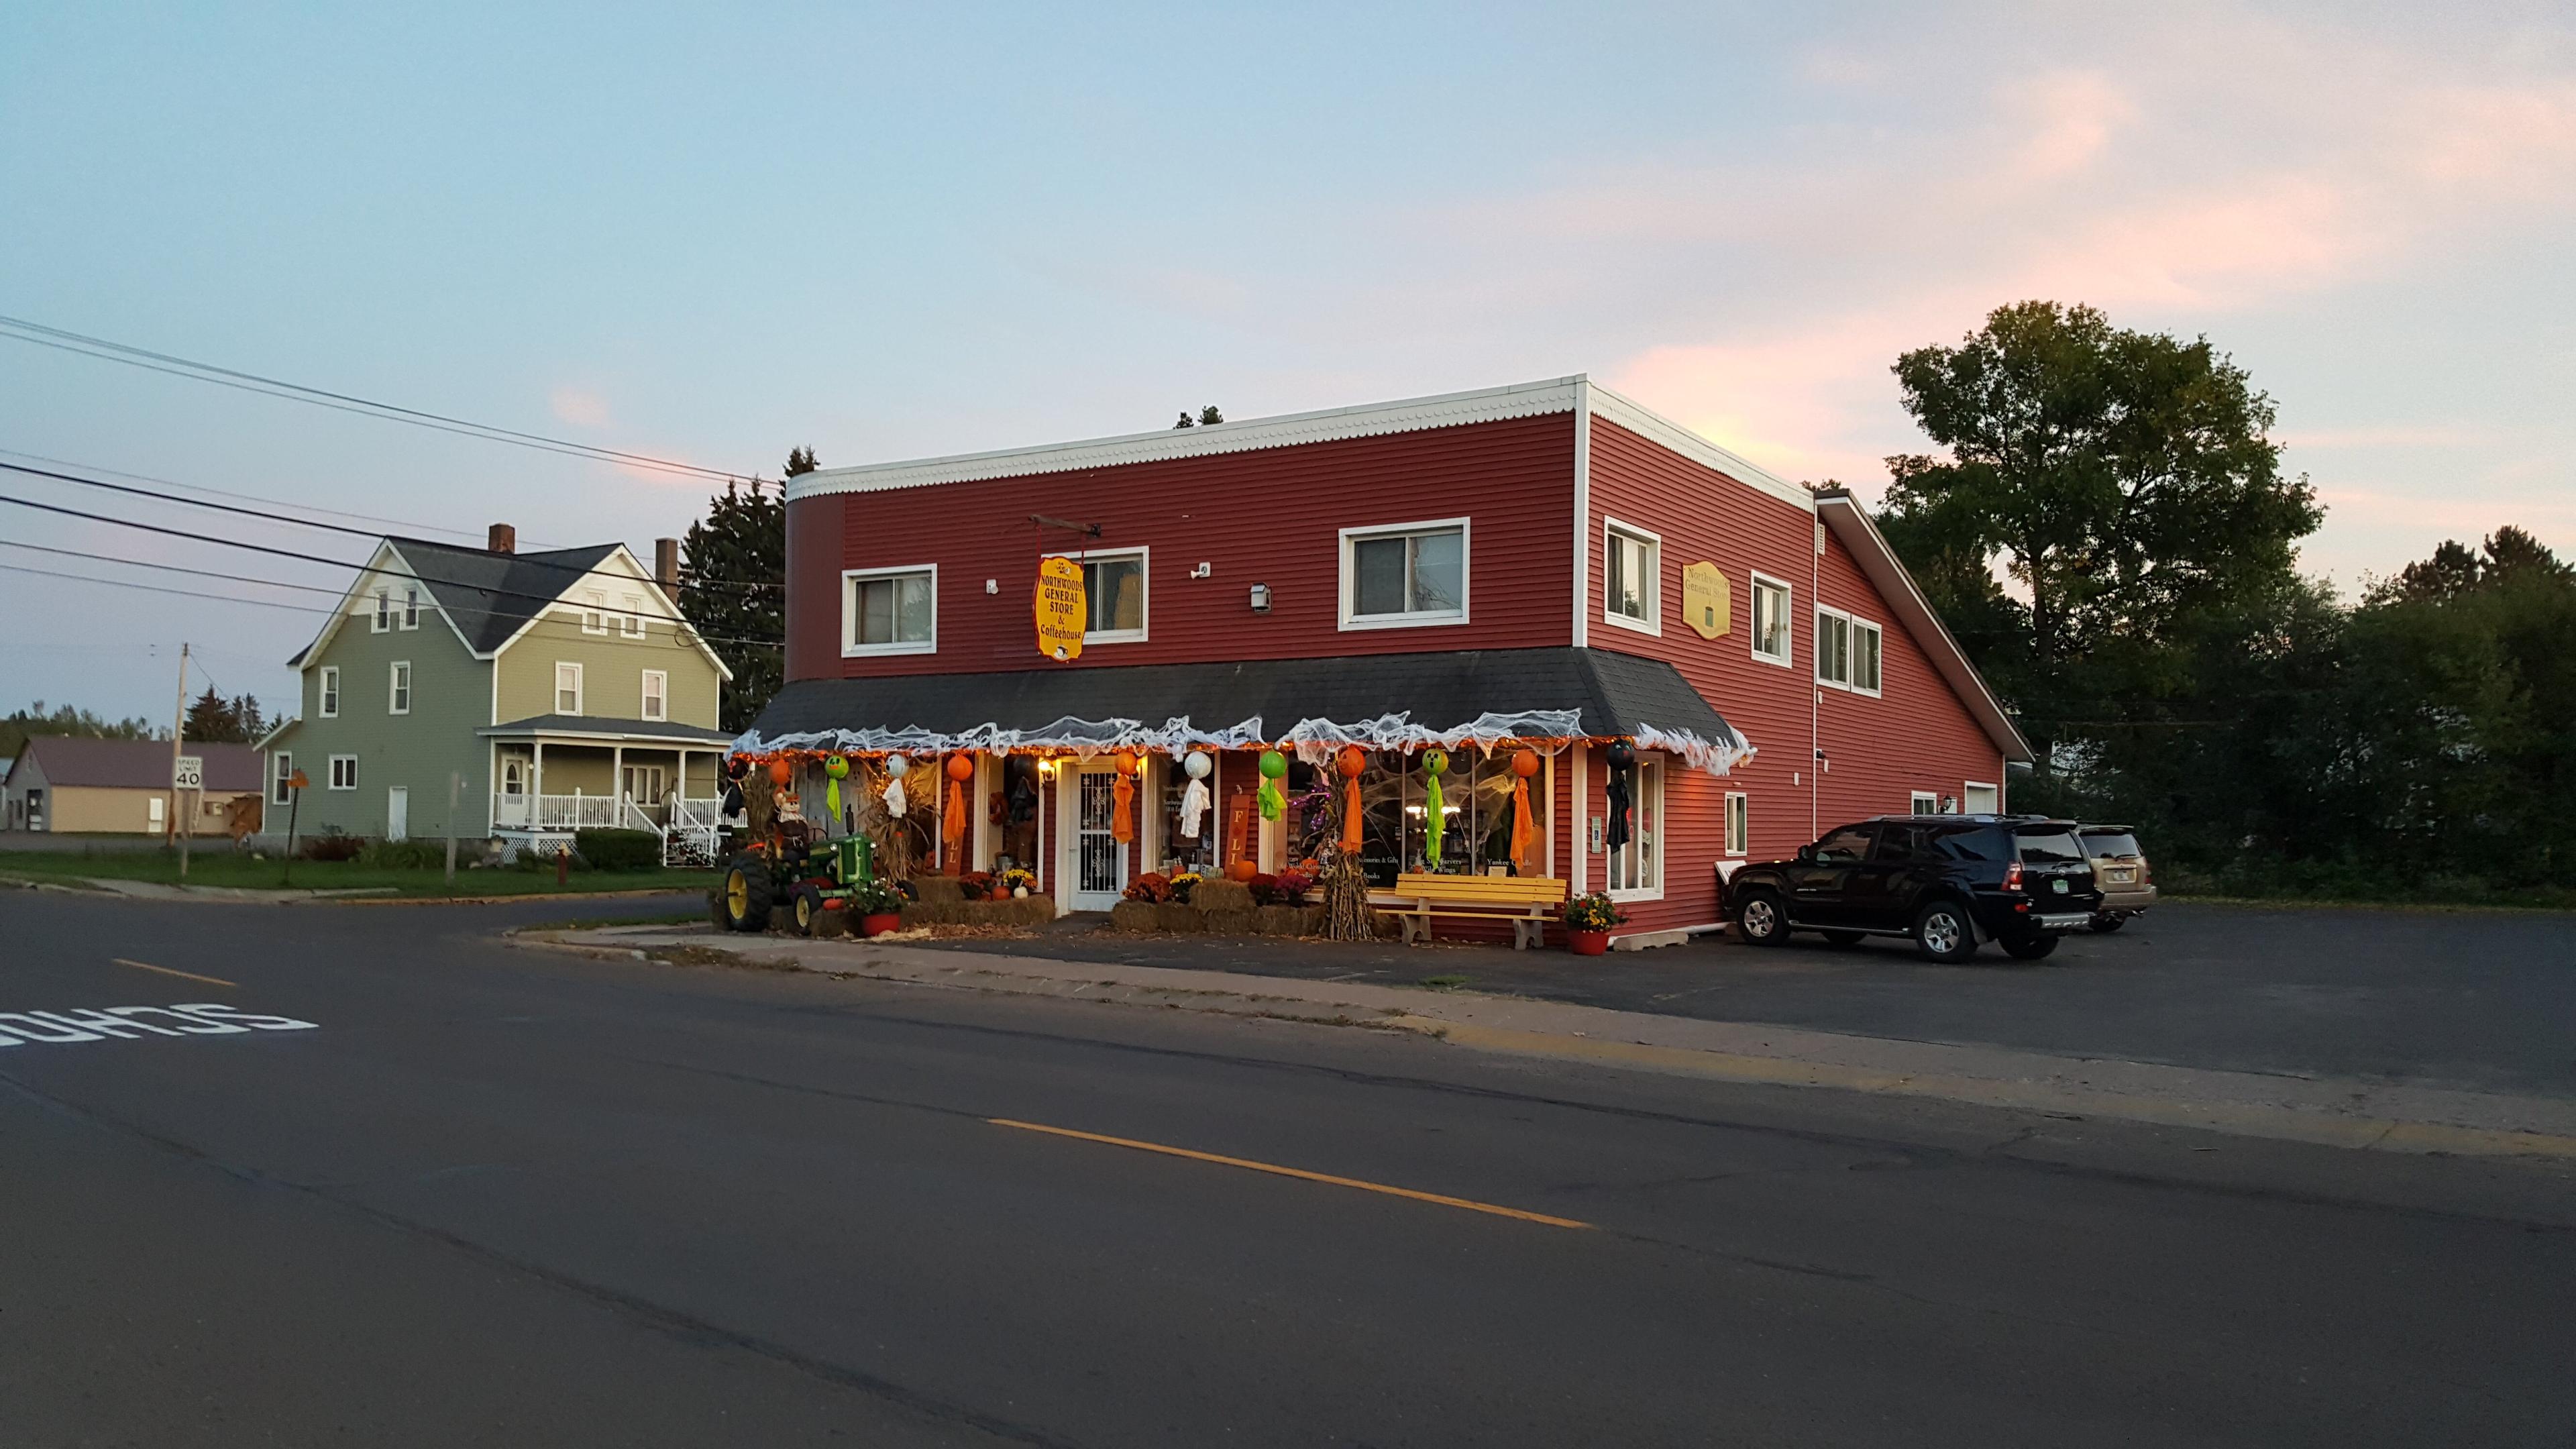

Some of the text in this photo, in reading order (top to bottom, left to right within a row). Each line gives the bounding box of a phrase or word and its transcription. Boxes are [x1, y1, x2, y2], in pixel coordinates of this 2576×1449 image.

[1041, 574, 1082, 592] NORTHWOODS
[1685, 579, 1712, 596] General
[1045, 588, 1079, 603] GENERAL
[1050, 601, 1073, 614] STORE
[1058, 614, 1065, 625] &
[1041, 624, 1081, 639] Coffeehouse
[176, 773, 199, 784] 40
[0, 1004, 319, 1046] SCHO
